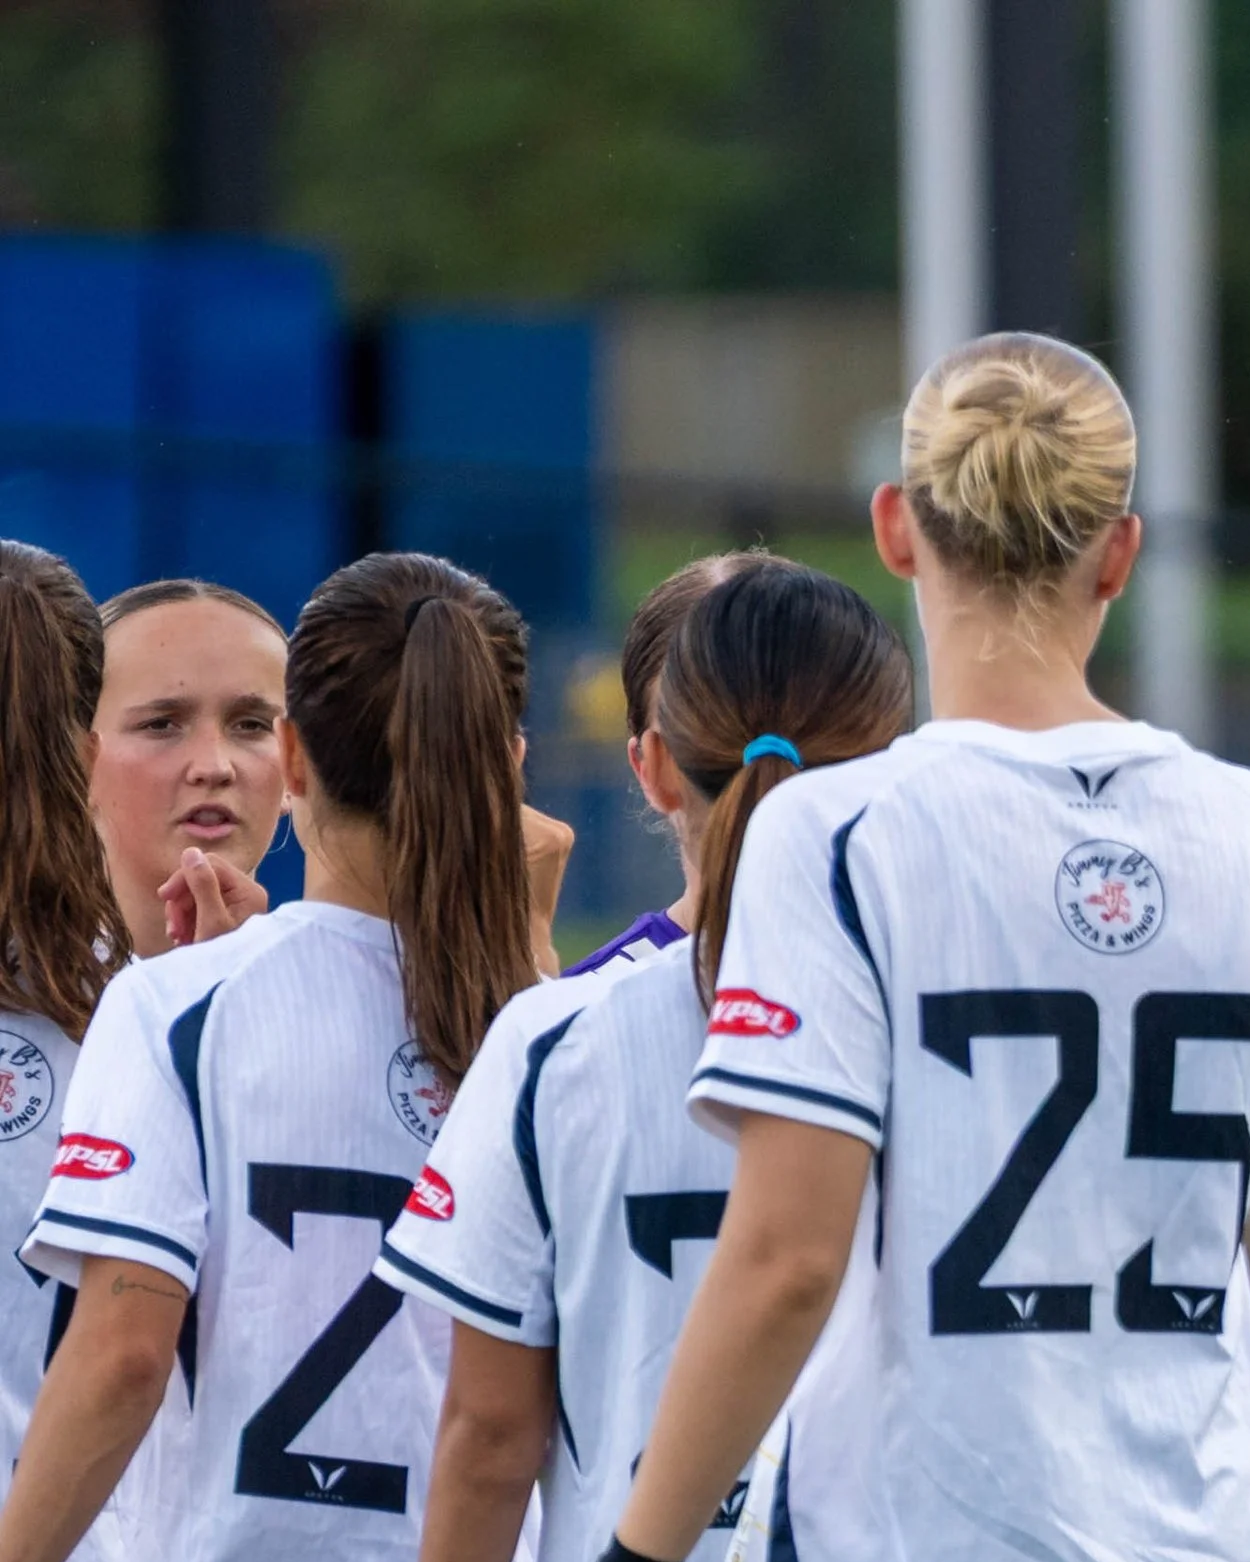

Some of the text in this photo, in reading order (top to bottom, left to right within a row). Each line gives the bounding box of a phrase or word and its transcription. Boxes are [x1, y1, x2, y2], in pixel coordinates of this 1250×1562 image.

[1062, 856, 1117, 887] Jimmy
[1067, 902, 1156, 947] PIZZA & WINGS
[0, 1095, 42, 1134] WINGS
[397, 1092, 428, 1136] PIZZA
